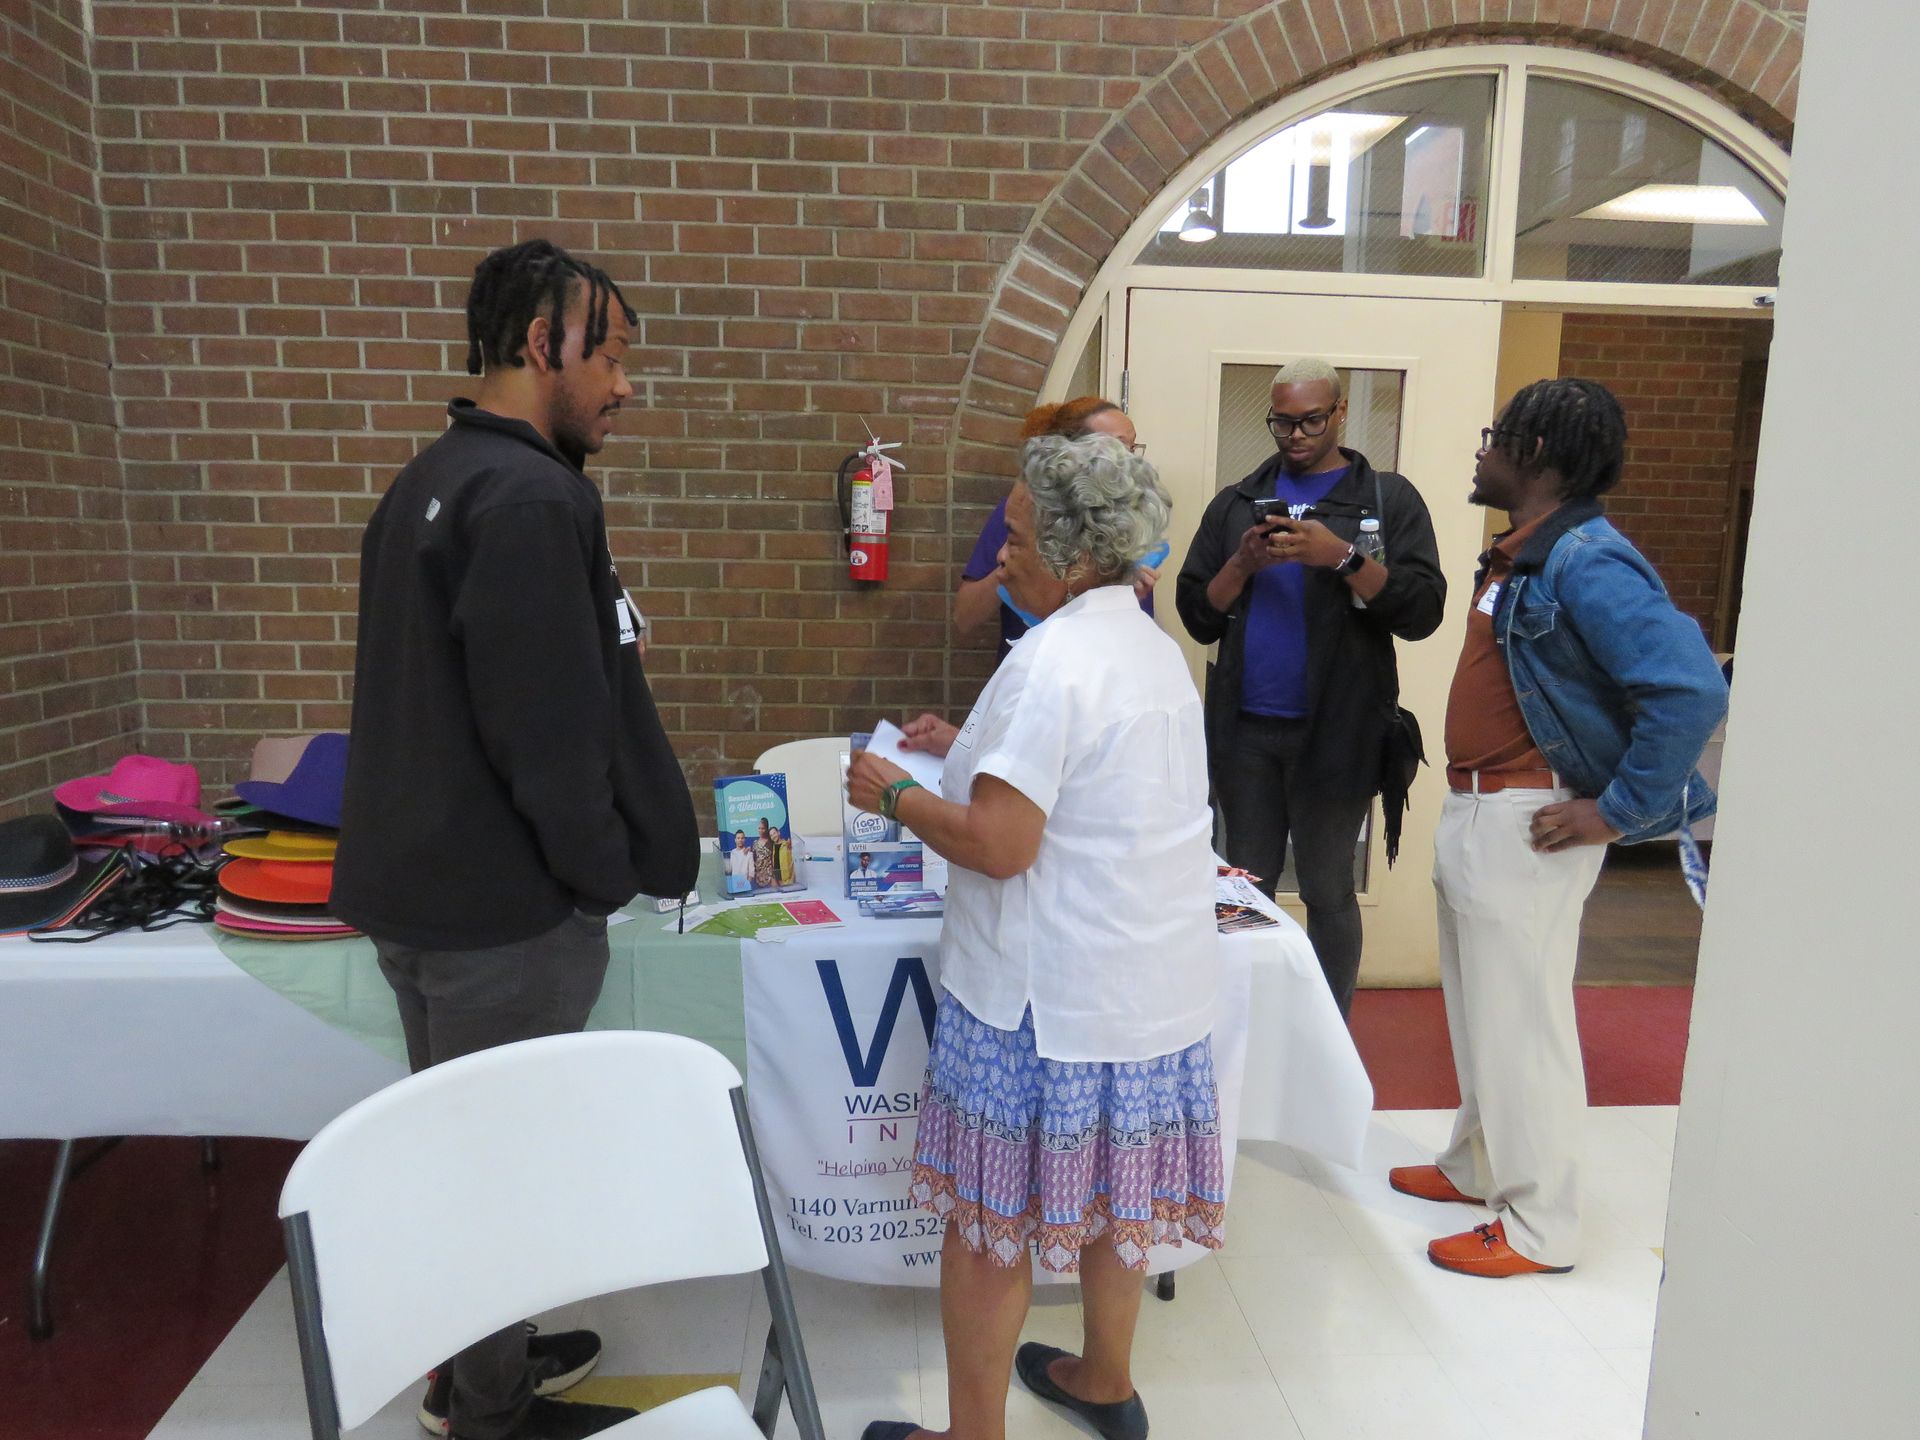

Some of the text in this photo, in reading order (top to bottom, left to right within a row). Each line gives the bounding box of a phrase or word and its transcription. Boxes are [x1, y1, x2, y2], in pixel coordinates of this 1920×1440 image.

[737, 801, 775, 811] Wellness
[857, 825, 882, 834] TESTED
[860, 817, 880, 828] GOT
[790, 1197, 836, 1217] 1140
[787, 1213, 818, 1240] Tel.
[824, 1225, 863, 1244] 203
[902, 1250, 942, 1267] ww
